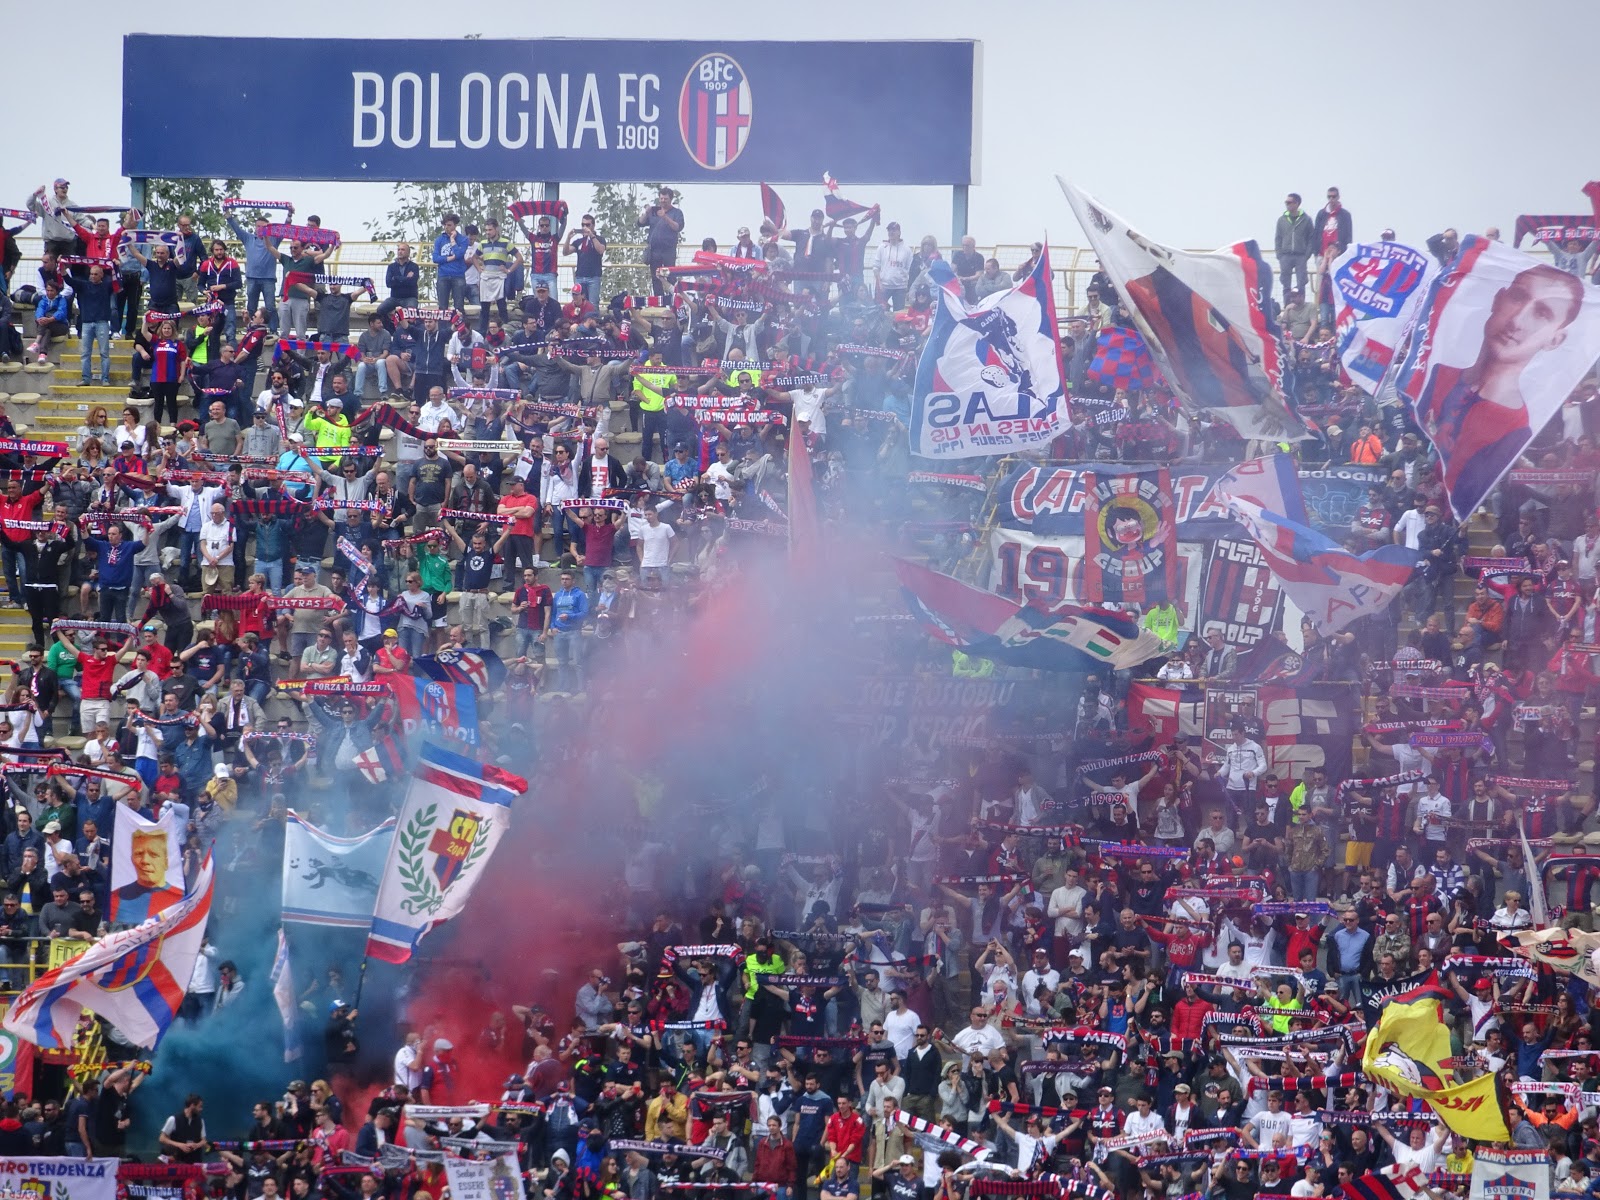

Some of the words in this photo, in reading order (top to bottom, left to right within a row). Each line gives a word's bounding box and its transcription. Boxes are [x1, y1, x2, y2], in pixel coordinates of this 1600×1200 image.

[705, 82, 728, 92] 1909
[352, 71, 607, 150] BOLOGNA
[619, 73, 660, 123] FC
[616, 125, 660, 150] 1909
[404, 308, 443, 320] BOLOGNA
[720, 360, 761, 370] BOLOGNA
[684, 396, 698, 406] TIFO
[699, 396, 714, 407] CON
[712, 411, 726, 421] TIFO
[727, 411, 740, 422] CON
[20, 443, 55, 452] RAGAZZI
[564, 499, 625, 508] BOLOGNA
[446, 509, 488, 521] BOLOGNA
[1093, 549, 1163, 577] GROUP
[1252, 581, 1263, 613] 1996
[278, 599, 321, 608] ULTRAS
[314, 683, 341, 691] FORZA
[344, 684, 381, 692] RAGAZZI
[1376, 721, 1406, 729] FORZA
[1091, 793, 1123, 805] 1909
[447, 841, 468, 857] 2004
[1189, 975, 1252, 988] BOLOGNA
[1368, 984, 1399, 1009] BELLA
[1220, 1032, 1279, 1043] Questione
[1371, 1112, 1409, 1120] BUCCE
[1509, 1152, 1532, 1163] CON
[458, 1181, 485, 1191] ESSERE
[1487, 1186, 1532, 1195] BOLOGNA
